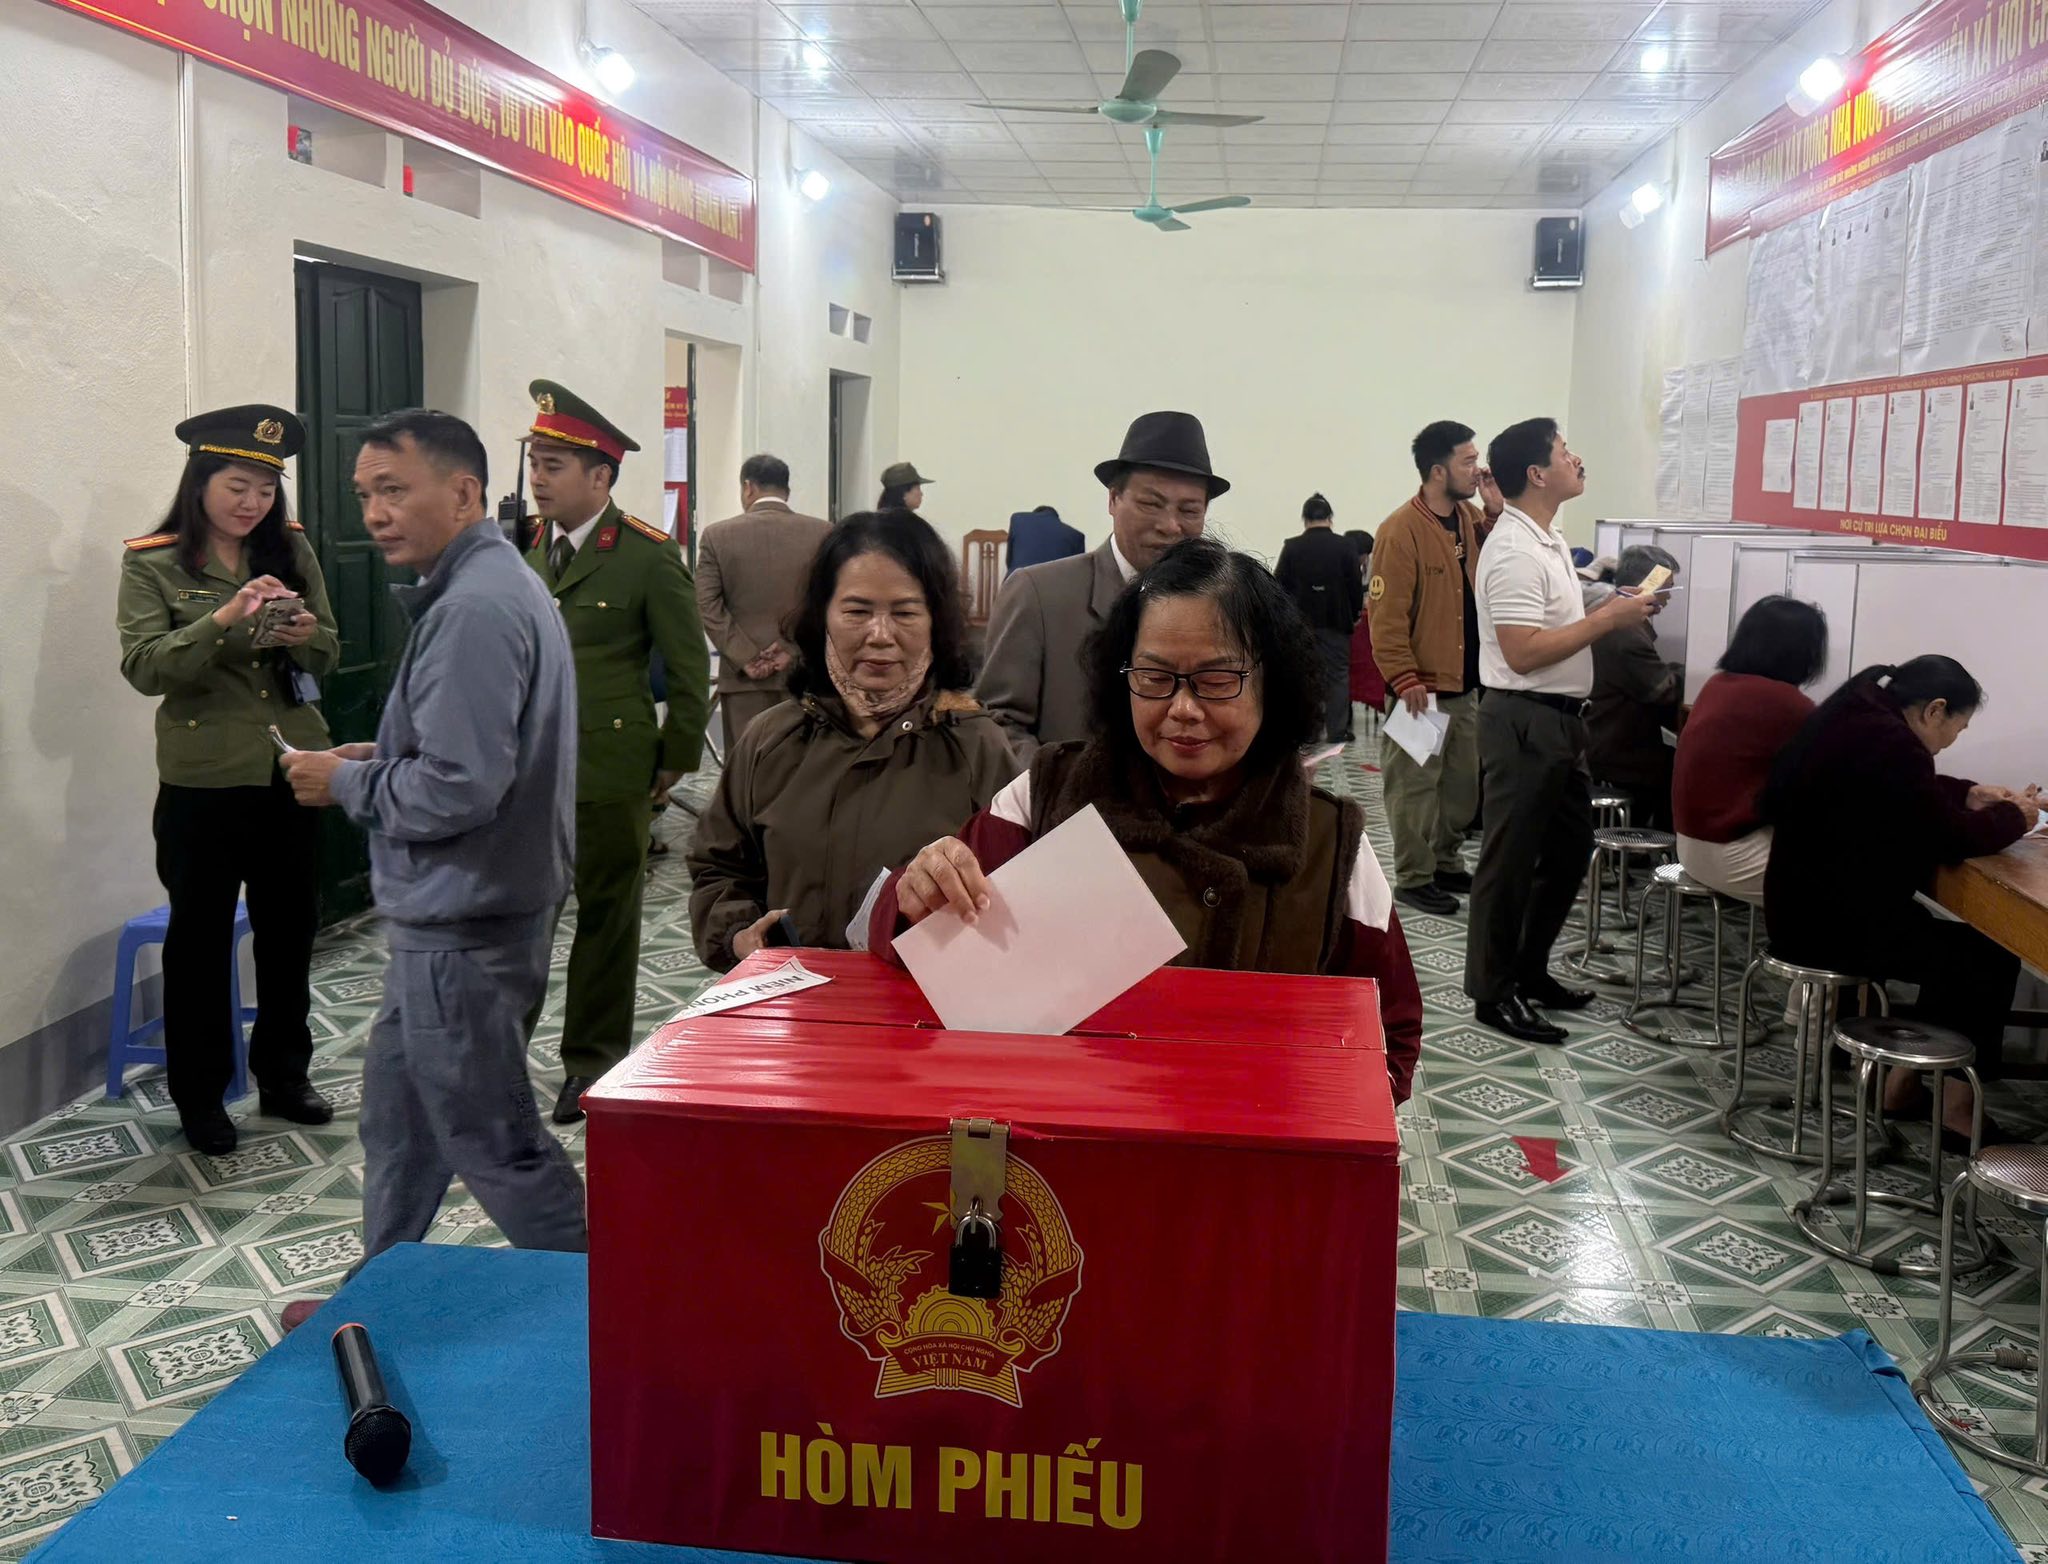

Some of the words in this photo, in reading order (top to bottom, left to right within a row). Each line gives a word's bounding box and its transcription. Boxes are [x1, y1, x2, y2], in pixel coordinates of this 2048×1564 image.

[365, 15, 426, 102] NGƯỜI
[430, 35, 454, 114] ĐỦ
[549, 102, 575, 167] VÀO
[577, 115, 610, 182] QUỐC
[611, 134, 631, 200] HỘI
[632, 144, 648, 200] VÀ
[1802, 113, 1829, 180] DỰNG
[1829, 88, 1852, 158] NHÀ
[1853, 517, 1863, 532] CỬ
[1864, 520, 1874, 532] TRI
[1875, 521, 1889, 537] LỰA
[1889, 523, 1913, 540] CHỌN
[1913, 525, 1928, 542] ĐẠI
[1929, 521, 1948, 541] BIỂU
[912, 1352, 949, 1367] VIỆT
[952, 1353, 987, 1370] NAM
[760, 1421, 912, 1510] HÒM
[938, 1437, 1143, 1530] PHIẾU
